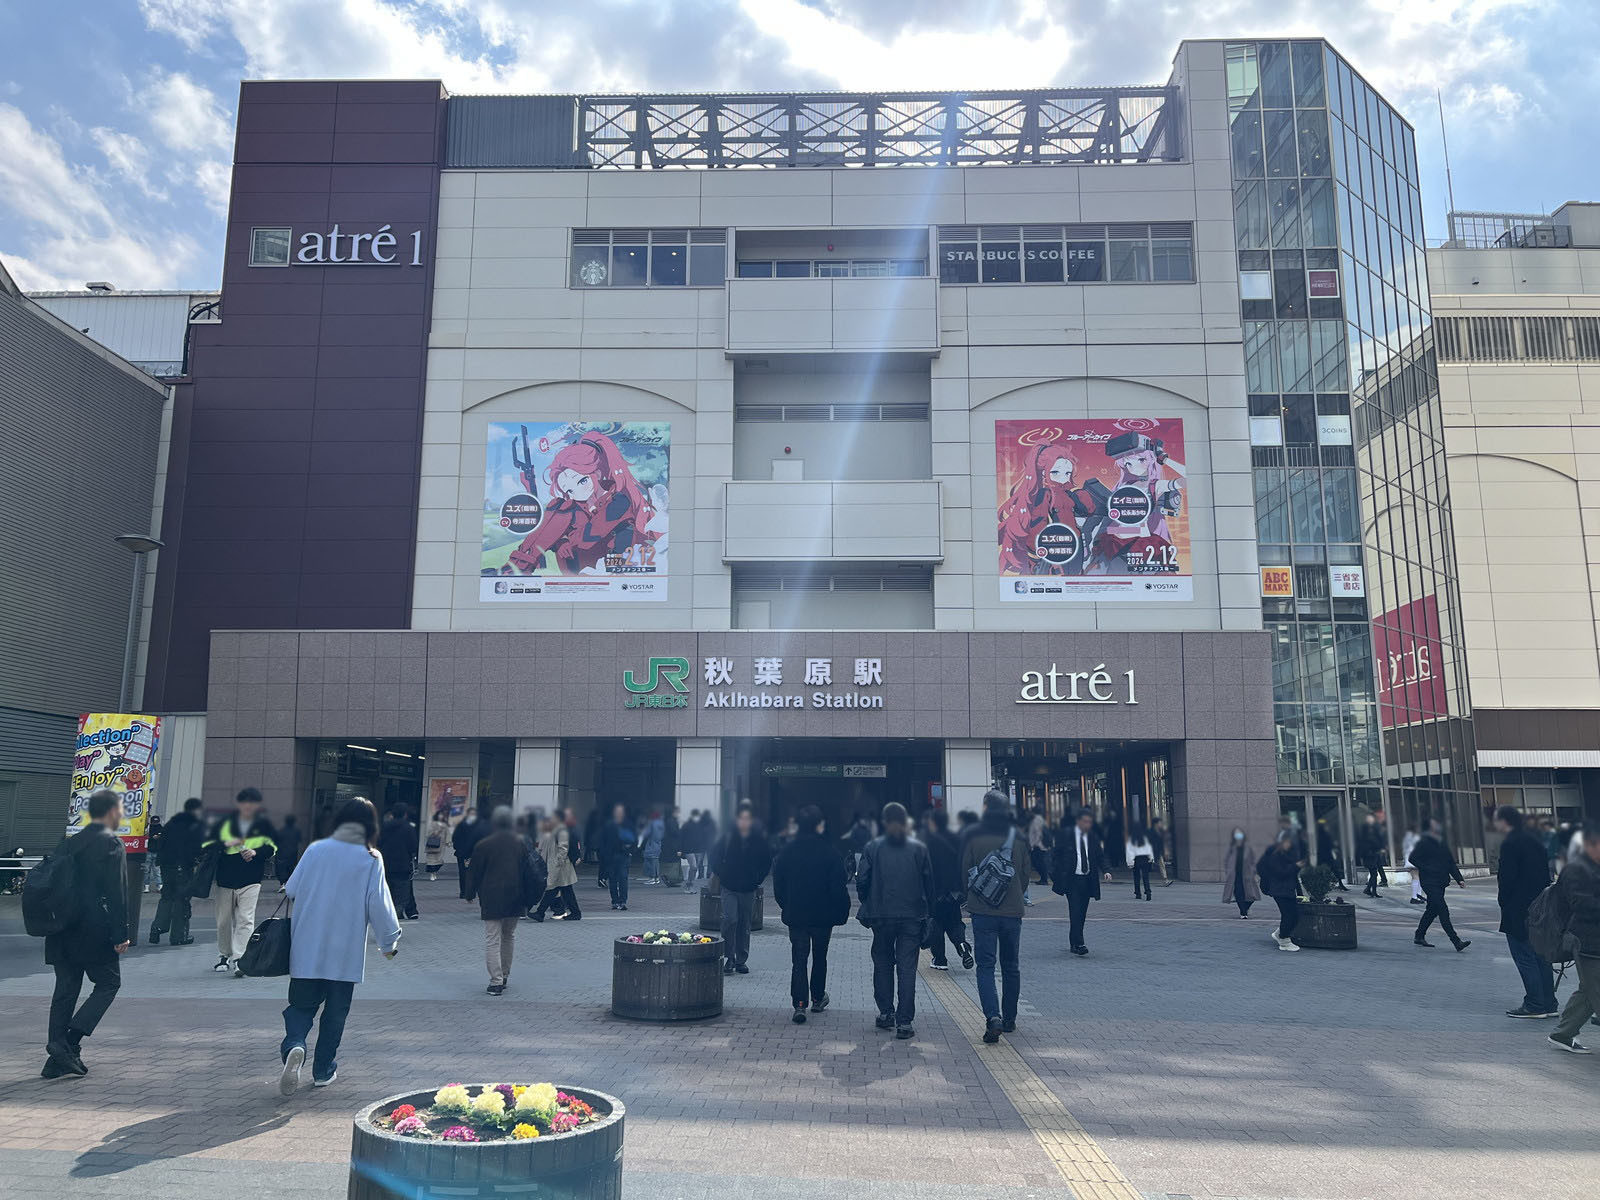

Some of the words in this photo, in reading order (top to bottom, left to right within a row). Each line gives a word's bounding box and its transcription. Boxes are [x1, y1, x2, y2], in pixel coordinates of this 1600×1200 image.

[297, 223, 398, 263] atré
[408, 230, 423, 266] 1
[946, 250, 1036, 261] STARBUCKS
[606, 558, 623, 566] 2026
[624, 546, 656, 566] 2.12
[1126, 557, 1144, 565] 2026
[1145, 545, 1178, 565] 2.12
[1264, 572, 1289, 584] ABC
[1333, 573, 1360, 582] 三省堂
[1264, 583, 1289, 592] MART
[1343, 582, 1361, 591] 書店
[623, 656, 690, 693] JR
[704, 657, 883, 686] 秋葉原駅
[1020, 663, 1113, 701] atré
[1123, 669, 1139, 704] 1
[624, 693, 689, 708] JR東日本
[704, 692, 804, 708] Akihabara
[812, 692, 883, 708] Station
